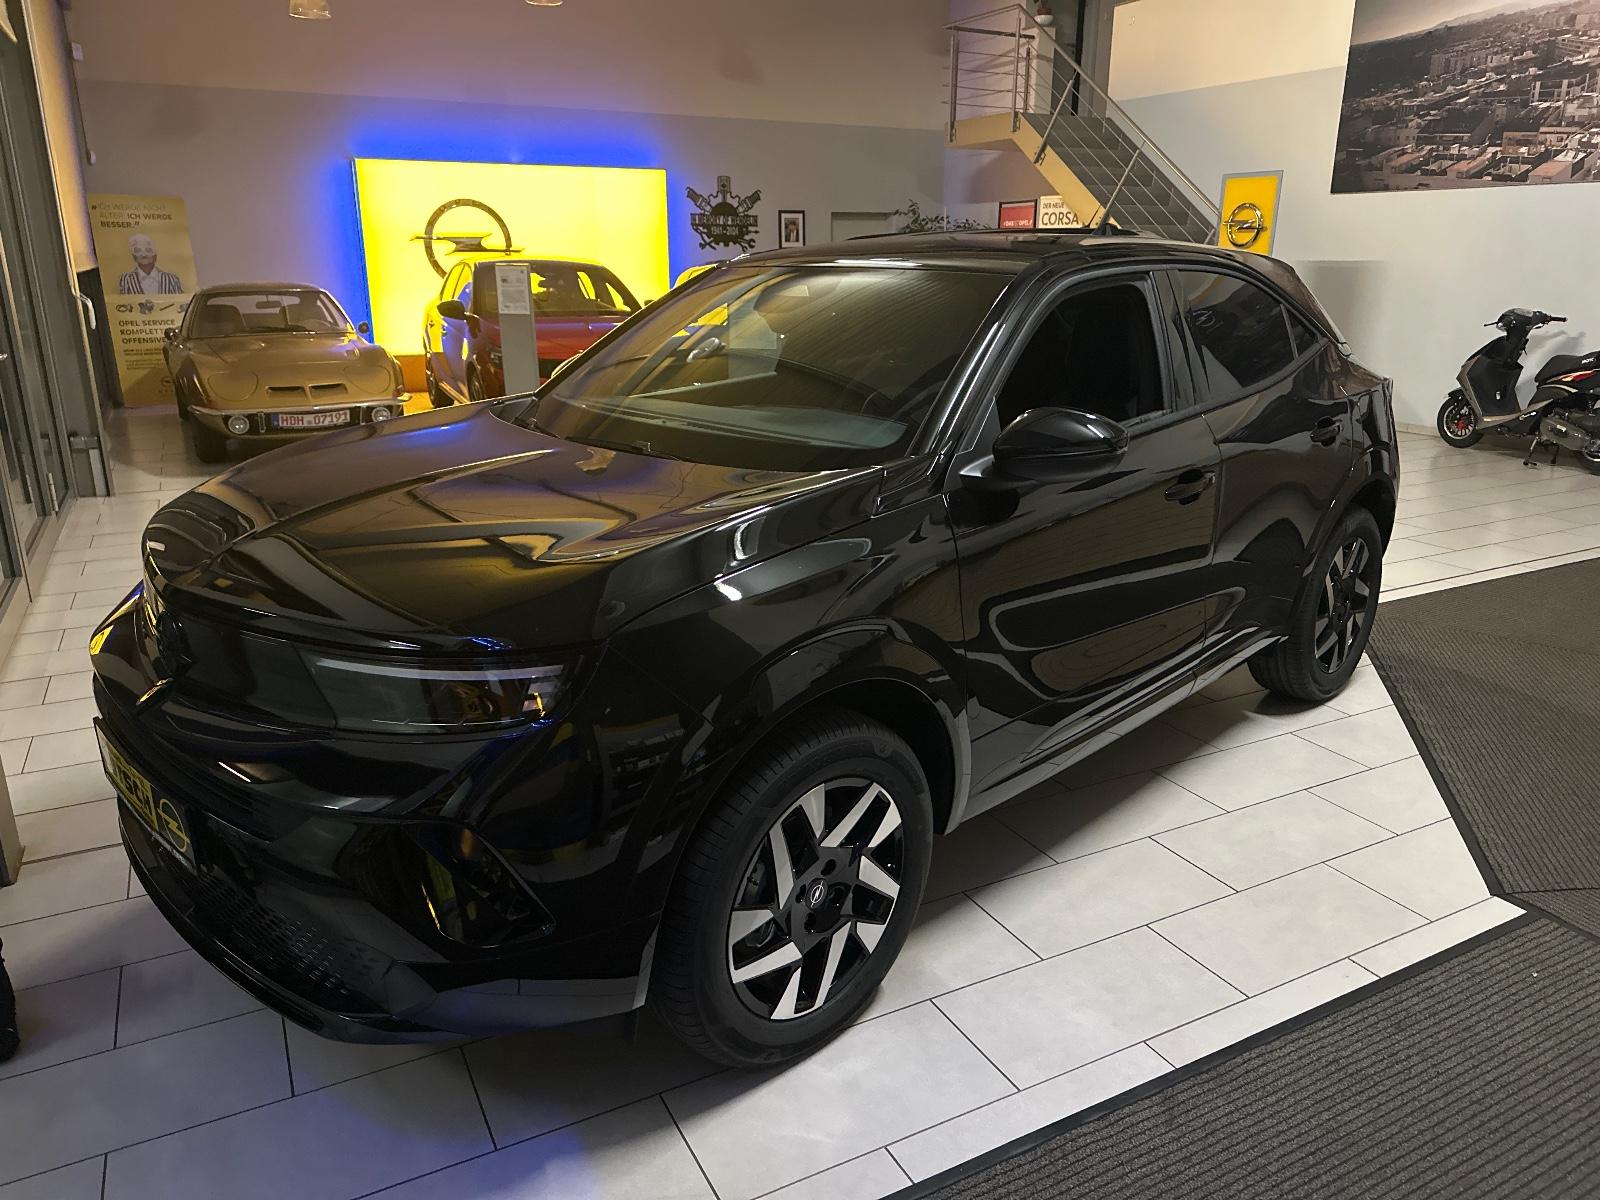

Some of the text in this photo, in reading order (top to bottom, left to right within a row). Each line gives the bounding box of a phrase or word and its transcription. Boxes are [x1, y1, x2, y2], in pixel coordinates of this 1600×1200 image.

[1041, 211, 1079, 226] CORSA
[281, 411, 348, 425] HDH 07191
